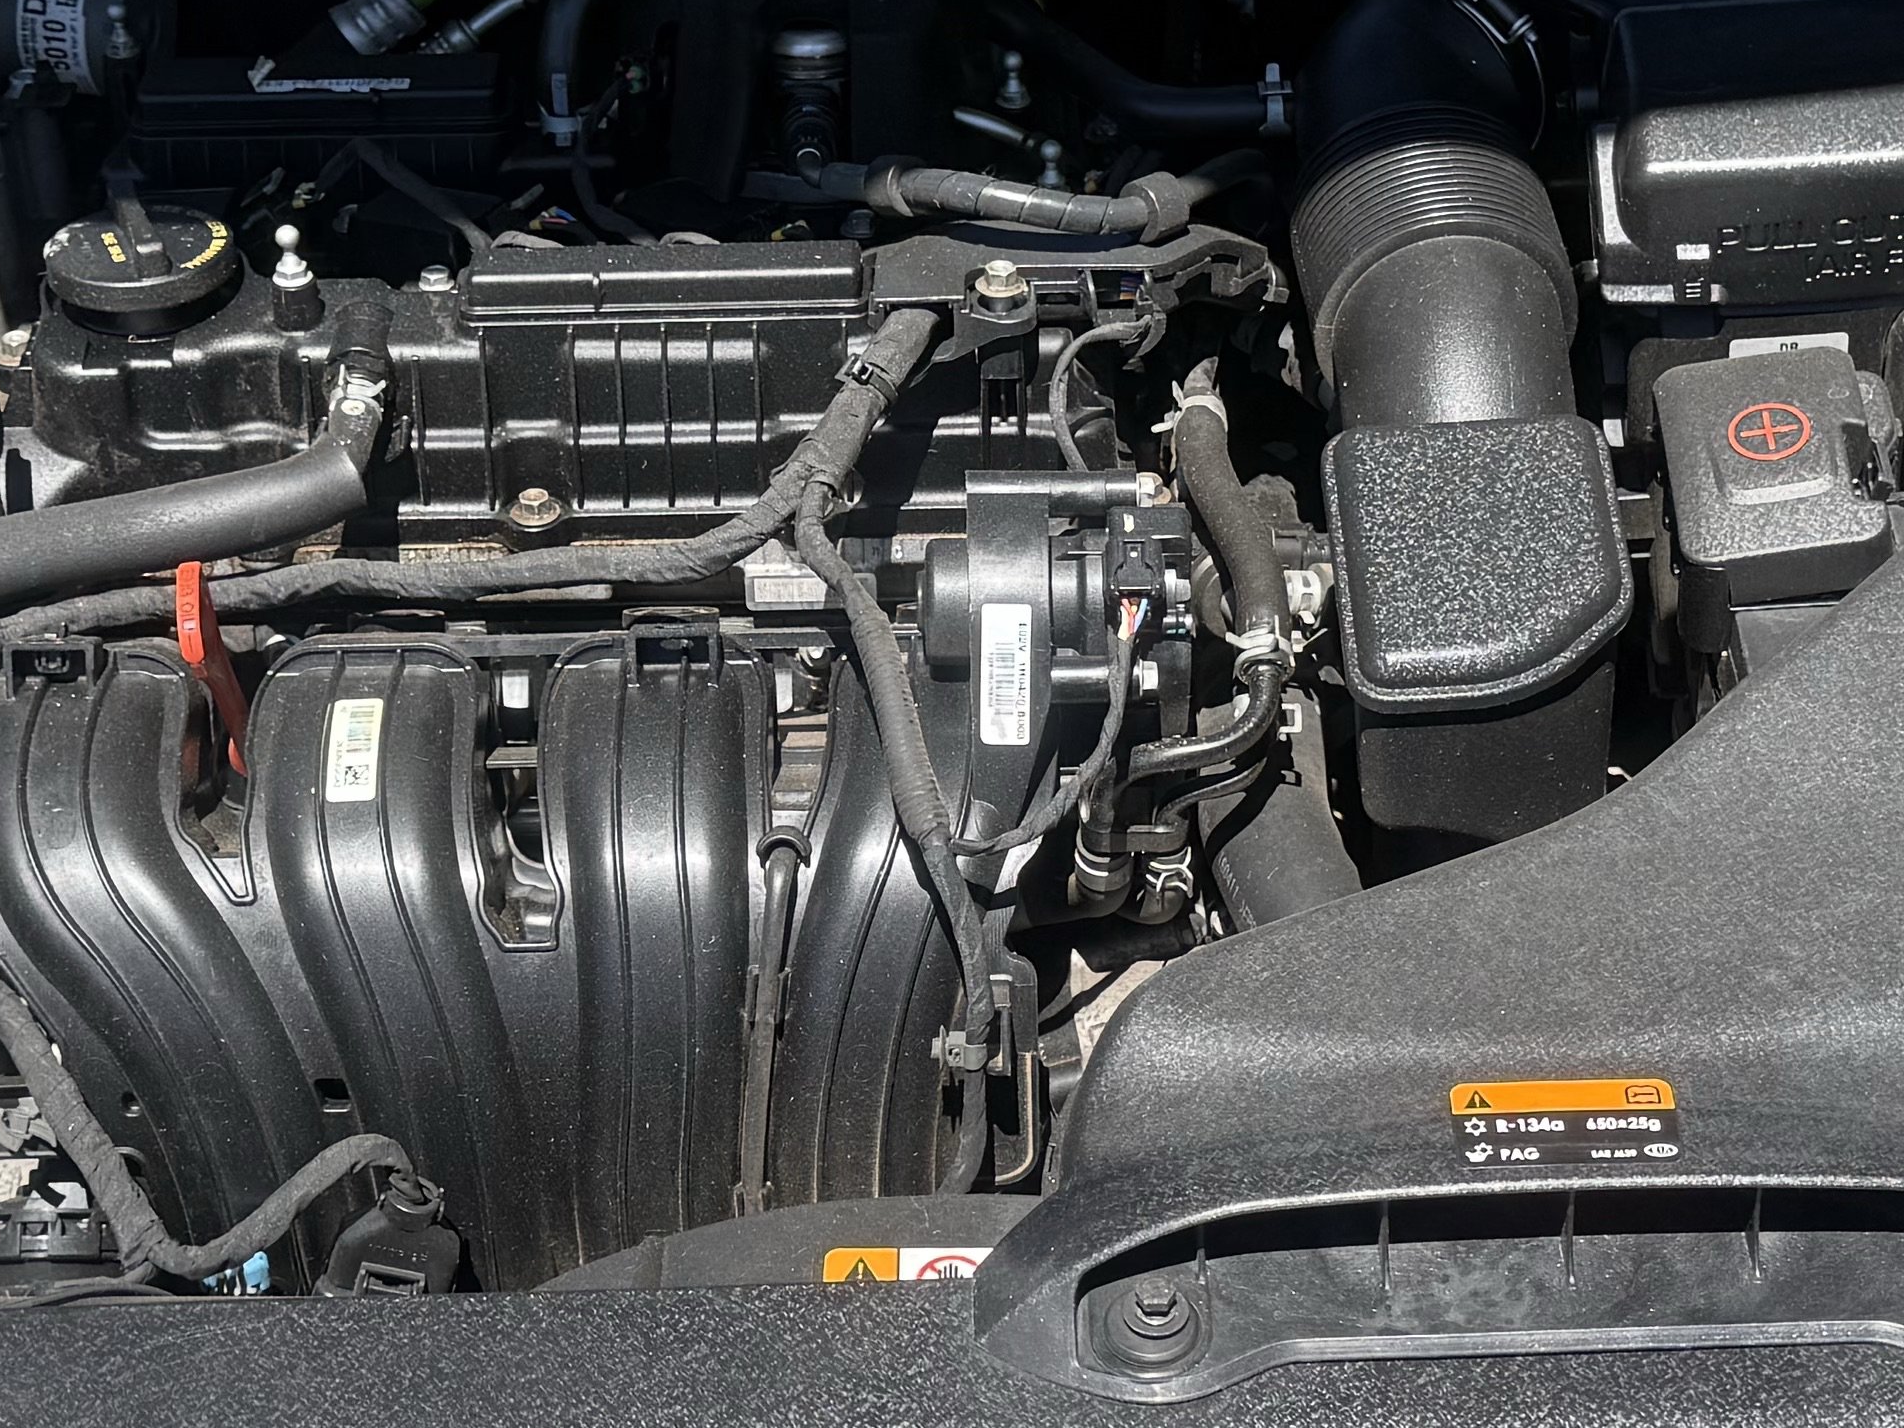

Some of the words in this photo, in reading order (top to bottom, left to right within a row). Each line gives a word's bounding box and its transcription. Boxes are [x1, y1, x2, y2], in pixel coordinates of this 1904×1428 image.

[1715, 221, 1819, 255] PULL
[1495, 1116, 1566, 1134] R-134a
[1499, 1147, 1541, 1161] PAG
